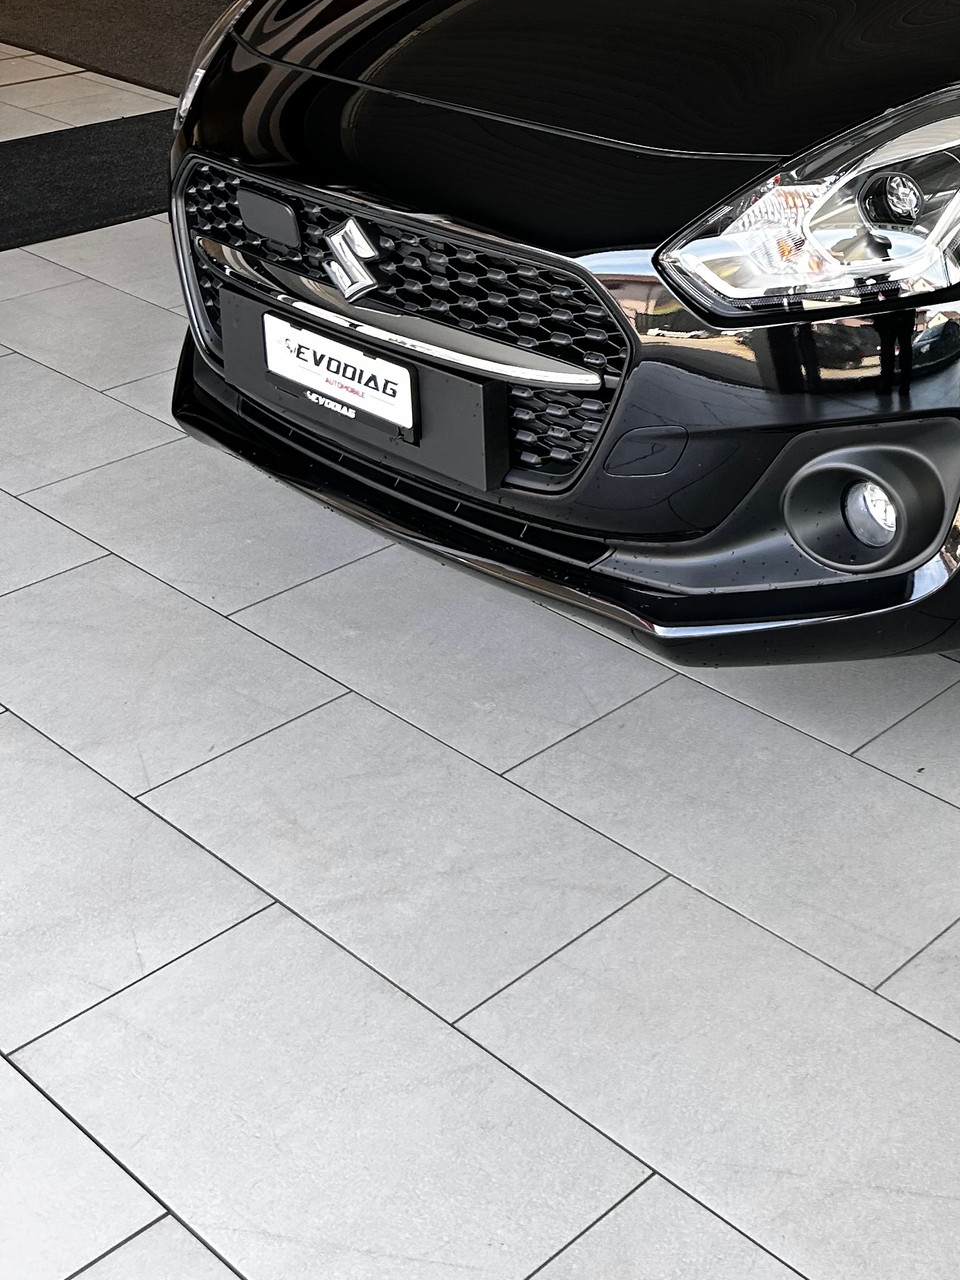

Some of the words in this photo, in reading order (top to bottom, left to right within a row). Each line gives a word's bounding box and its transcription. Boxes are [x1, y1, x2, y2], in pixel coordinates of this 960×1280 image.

[296, 343, 399, 398] EVODIAG
[324, 376, 366, 399] AUTOMOBILE
[311, 392, 357, 419] EVODIAG
